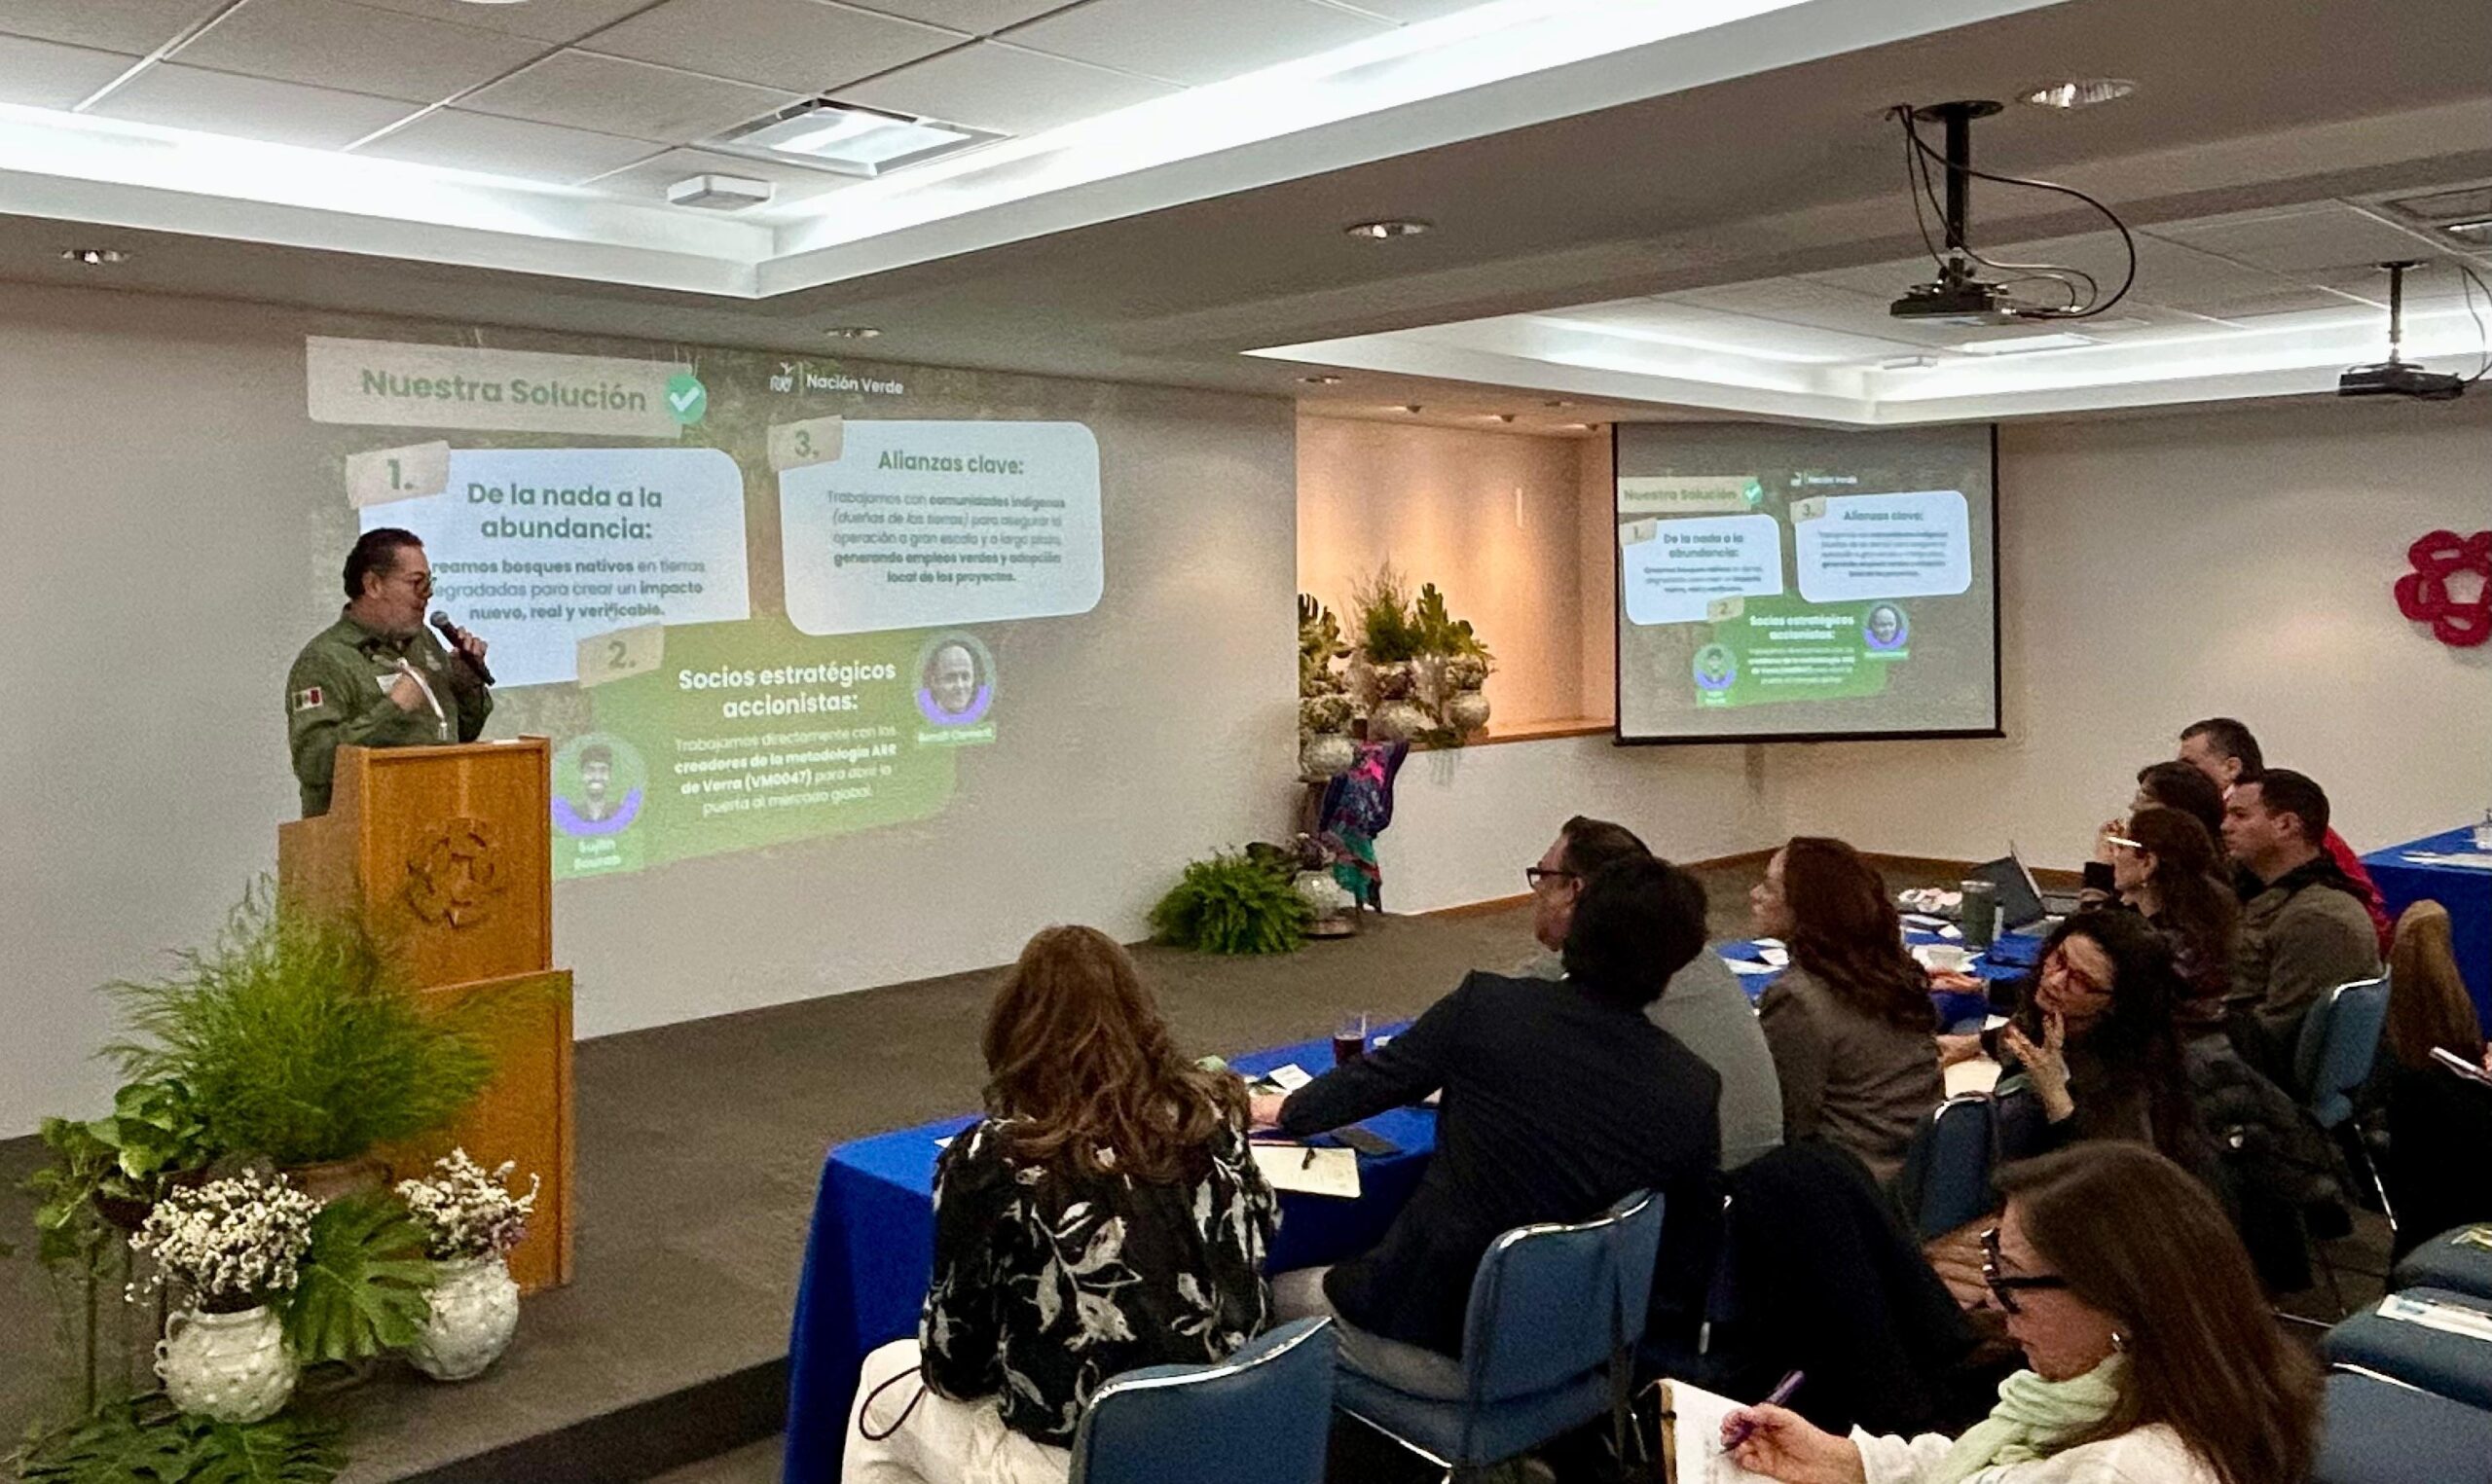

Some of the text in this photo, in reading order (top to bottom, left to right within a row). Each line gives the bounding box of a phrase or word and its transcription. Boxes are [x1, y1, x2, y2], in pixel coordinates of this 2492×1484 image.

[361, 368, 647, 413] Nuestra Solución
[806, 374, 859, 391] Nación
[861, 378, 904, 394] Verde
[794, 430, 820, 458] 3.
[878, 450, 1024, 475] Alianzas clave:
[386, 458, 415, 490] 1.
[466, 482, 663, 508] De la nada a la
[827, 489, 901, 507] Trabajamos
[904, 494, 926, 505] con
[929, 493, 1009, 507] comunidades
[1623, 488, 1738, 501] Nuestra Solución
[888, 511, 903, 525] de
[481, 517, 652, 540] abundancia:
[910, 534, 937, 548] gran
[431, 560, 497, 573] reamos
[502, 560, 571, 576] bosques
[575, 560, 634, 573] nativos
[638, 561, 656, 573] en
[833, 552, 903, 567] generando
[905, 552, 957, 567] empleos
[887, 570, 917, 583] local
[919, 571, 934, 583] de
[936, 571, 953, 583] los
[432, 581, 703, 601] egradadas para crear un impacto
[469, 607, 528, 623] nuevo,
[531, 604, 562, 619] real
[566, 606, 575, 622] y
[607, 640, 637, 670] 2.
[678, 660, 897, 692] Socios estratégicos
[722, 692, 859, 719] accionistas:
[852, 727, 876, 739] con
[674, 756, 748, 775] creadores
[750, 753, 769, 768] de
[680, 780, 701, 795] de
[702, 778, 743, 793] Verra
